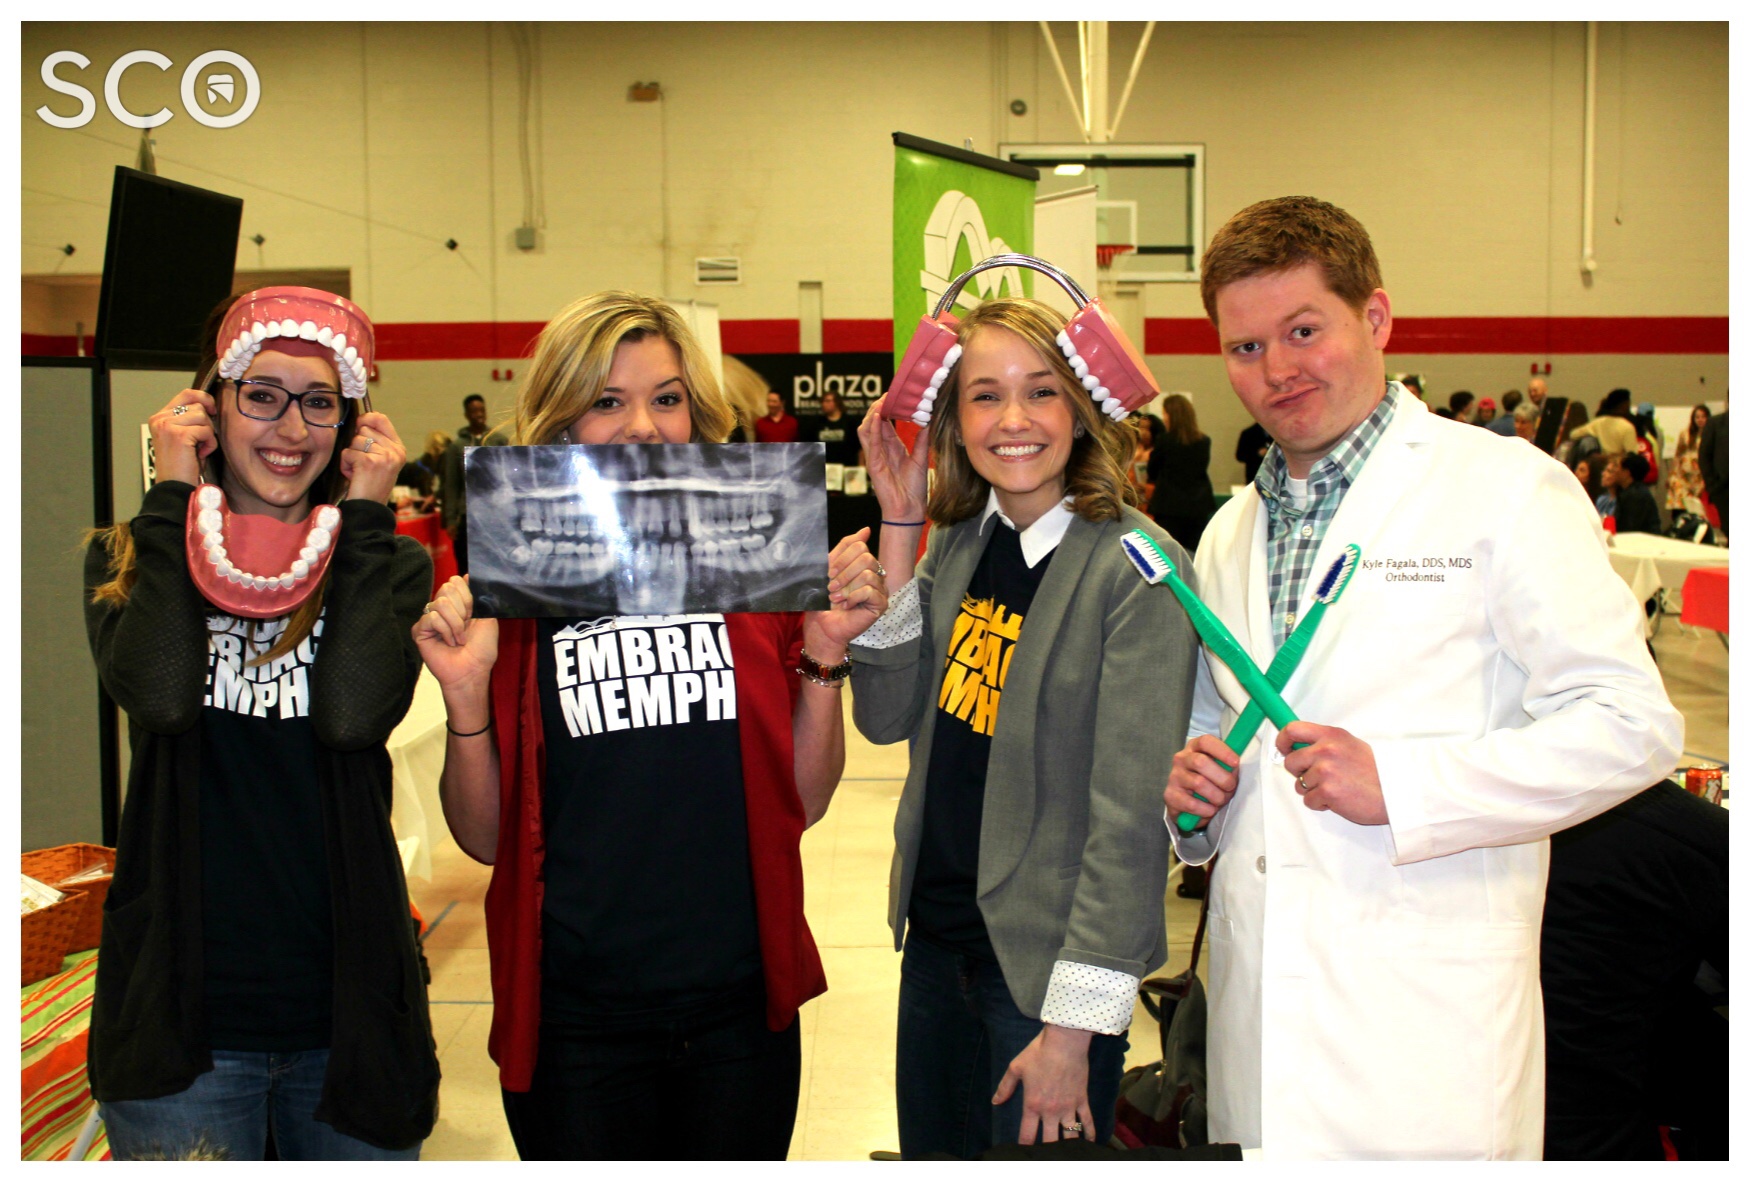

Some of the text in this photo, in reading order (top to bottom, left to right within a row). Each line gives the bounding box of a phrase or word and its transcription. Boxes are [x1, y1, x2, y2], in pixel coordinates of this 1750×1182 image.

[794, 361, 882, 409] plaza
[1362, 557, 1473, 570] Kyle Fagala, DDS, MDS
[1385, 572, 1446, 583] Orthodontist
[558, 669, 737, 738] MEMPH
